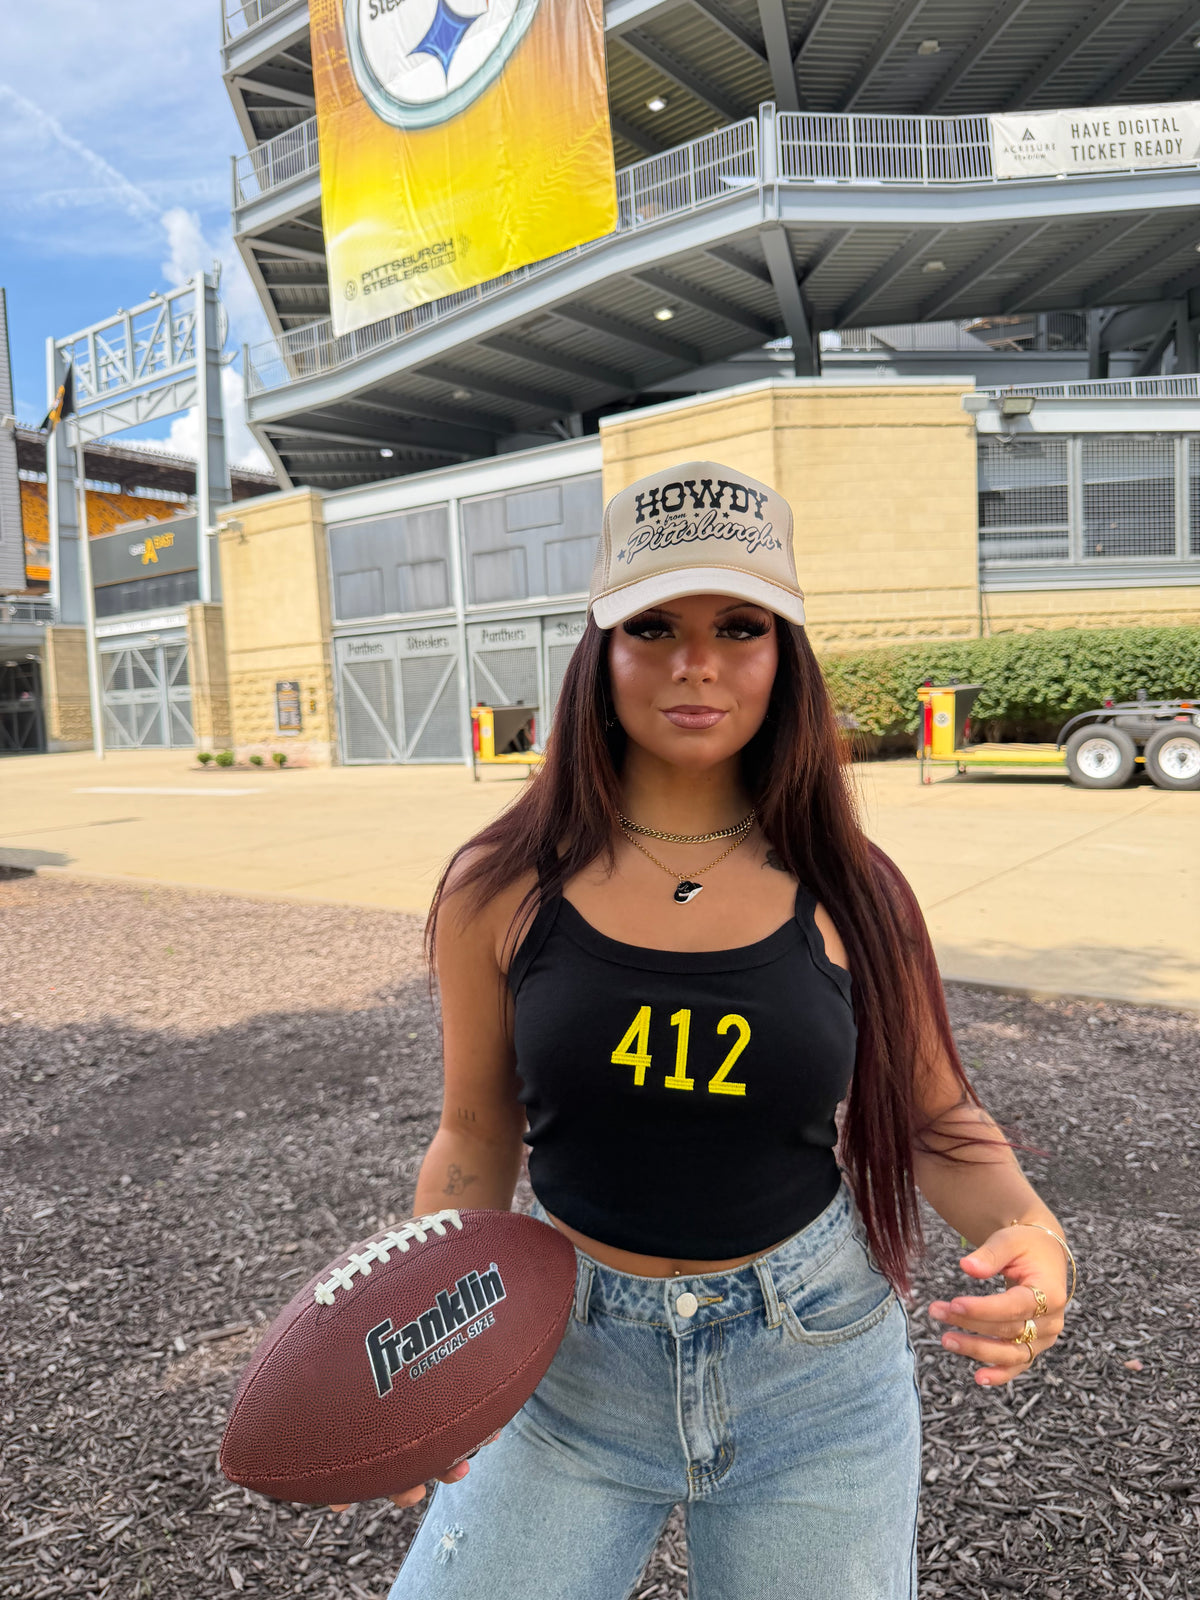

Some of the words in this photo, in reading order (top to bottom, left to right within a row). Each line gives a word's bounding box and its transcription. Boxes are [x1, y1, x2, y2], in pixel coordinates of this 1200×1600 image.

[1071, 122, 1111, 139] HAVE
[1118, 117, 1180, 136] DIGITAL
[1004, 143, 1057, 154] ACRISURE
[1071, 142, 1127, 161] TICKET
[1134, 138, 1183, 157] READY
[361, 237, 454, 284] PITTSBURGH
[362, 262, 429, 296] STEELERS
[635, 479, 769, 524] HOWDY
[663, 512, 687, 526] from
[626, 509, 776, 565] Pittsburgh
[407, 636, 450, 650] Steelers
[610, 1005, 752, 1096] 412
[409, 1333, 468, 1380] OFFICIAL
[467, 1311, 497, 1340] SIZE
